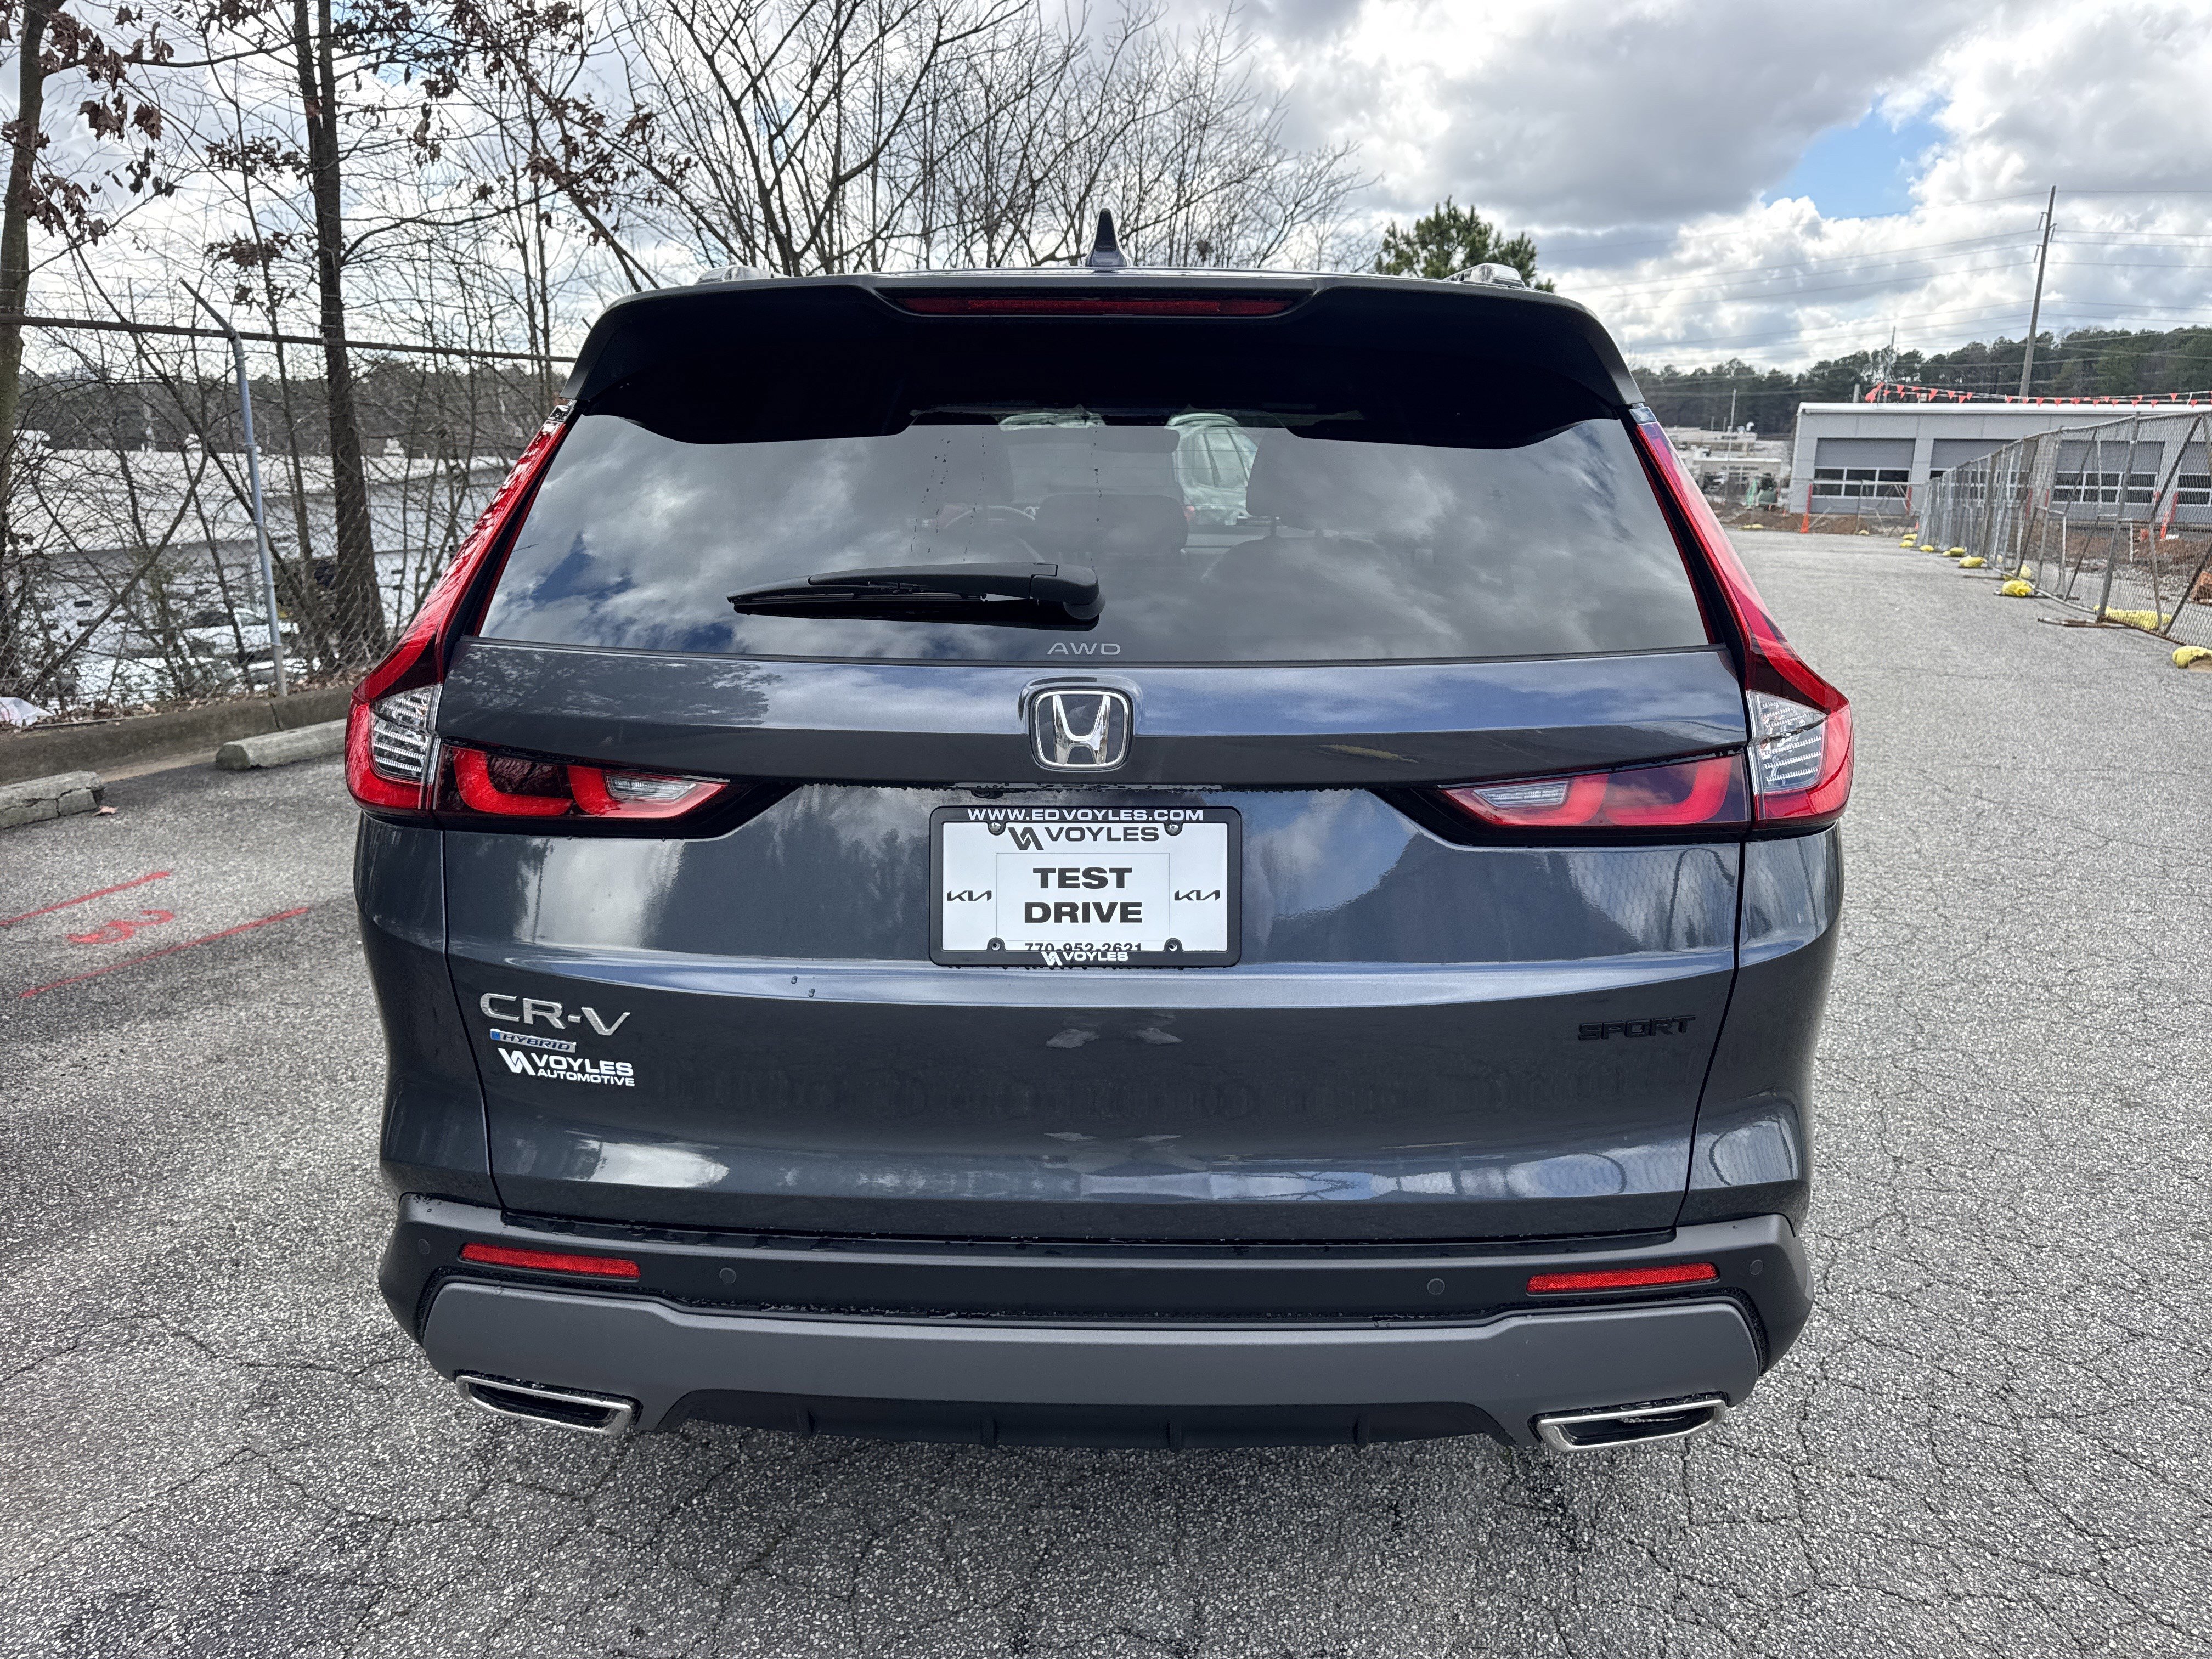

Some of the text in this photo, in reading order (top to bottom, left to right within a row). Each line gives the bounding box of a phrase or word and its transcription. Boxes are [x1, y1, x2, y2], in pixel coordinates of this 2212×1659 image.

[1047, 642, 1121, 656] AWD
[967, 809, 1204, 821] WWW.EDVOYLES.COM
[1044, 826, 1159, 842] VOYLES
[1032, 867, 1132, 889] TEST
[1024, 902, 1142, 923] DRIVE
[1062, 951, 1129, 961] VOYLES
[479, 992, 631, 1036] CR-V
[1577, 1015, 1696, 1041] SPORT
[502, 1033, 571, 1051] HYBRID
[530, 1052, 634, 1076] VOYLES
[537, 1068, 635, 1087] AUTOMOTIVE
